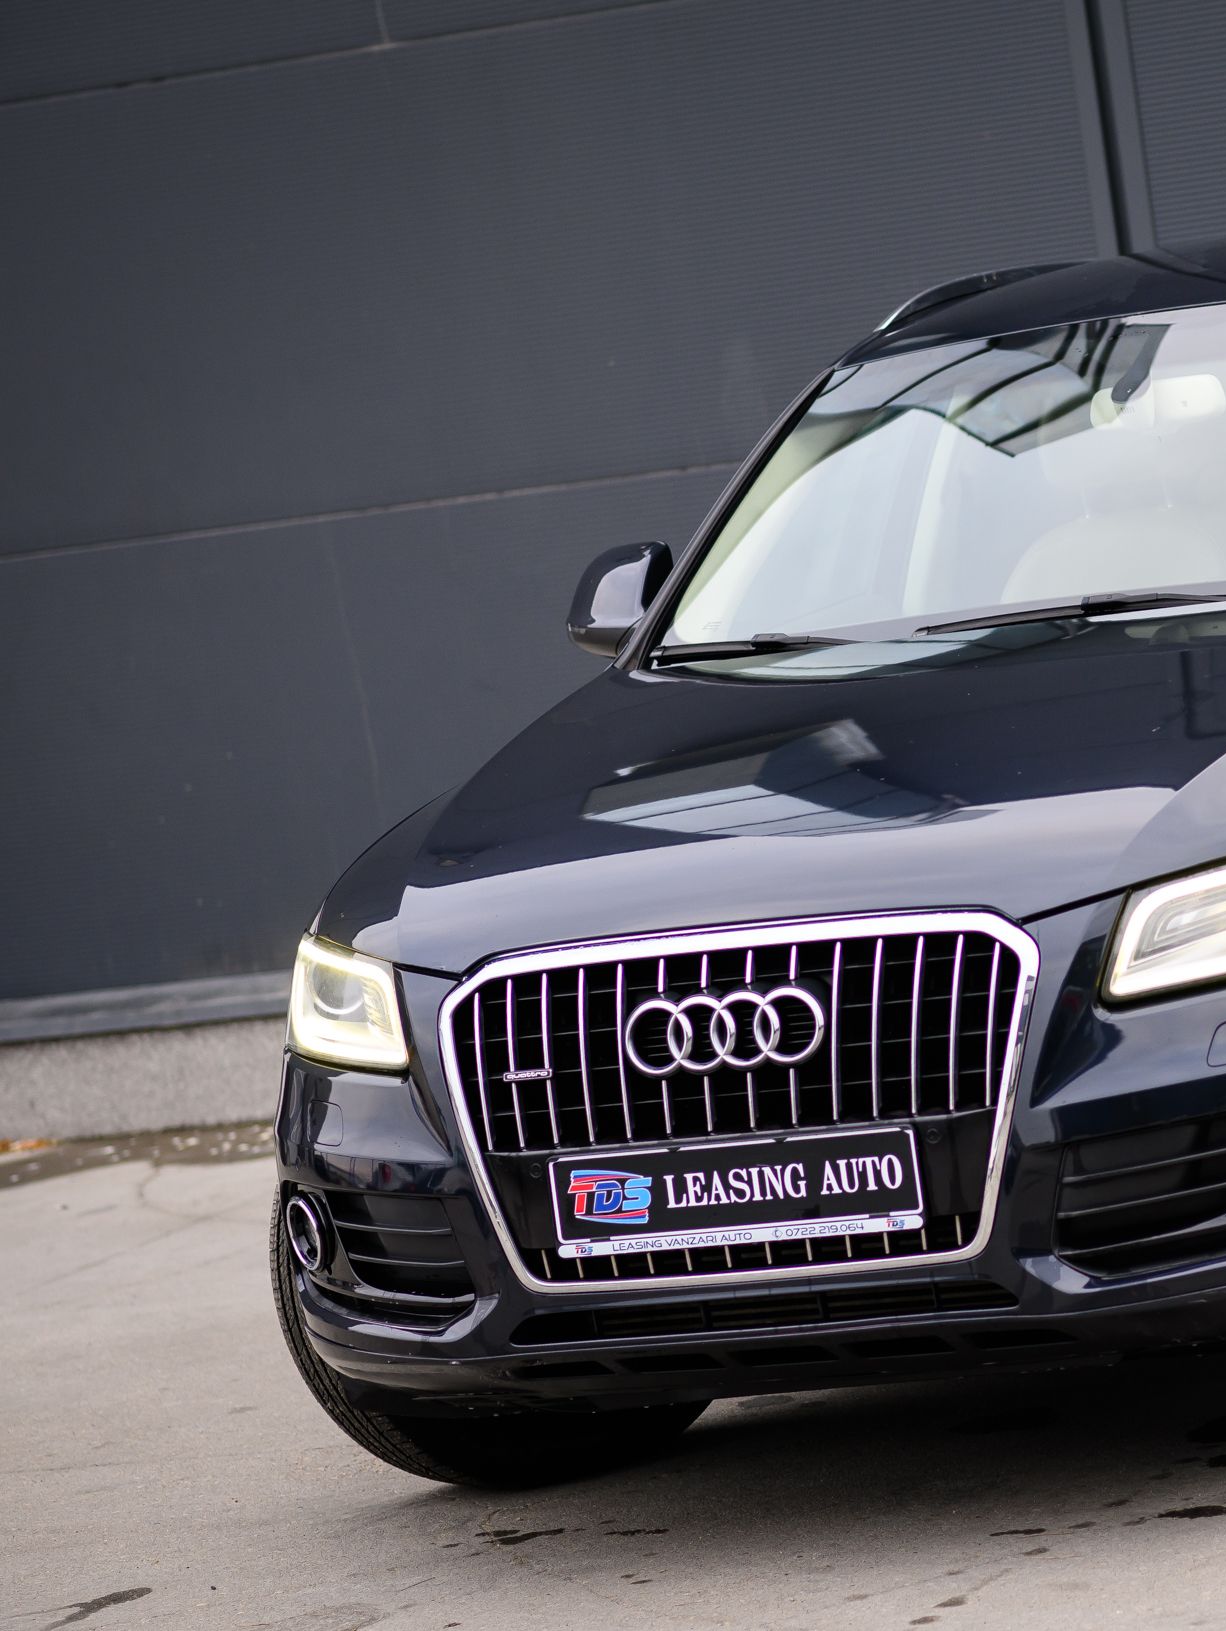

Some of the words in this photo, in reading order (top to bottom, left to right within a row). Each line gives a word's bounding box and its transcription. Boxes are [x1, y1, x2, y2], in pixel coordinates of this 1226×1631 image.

[506, 1071, 548, 1080] quattro
[663, 1163, 806, 1209] LEASING
[820, 1154, 903, 1195] AUTO
[567, 1176, 652, 1216] TDS
[786, 1222, 864, 1237] 0722.219.064
[886, 1219, 905, 1229] TDS
[612, 1239, 663, 1252] LEASING
[665, 1235, 718, 1247] VANZARI
[720, 1232, 753, 1242] AUTO
[575, 1245, 593, 1255] TDS
